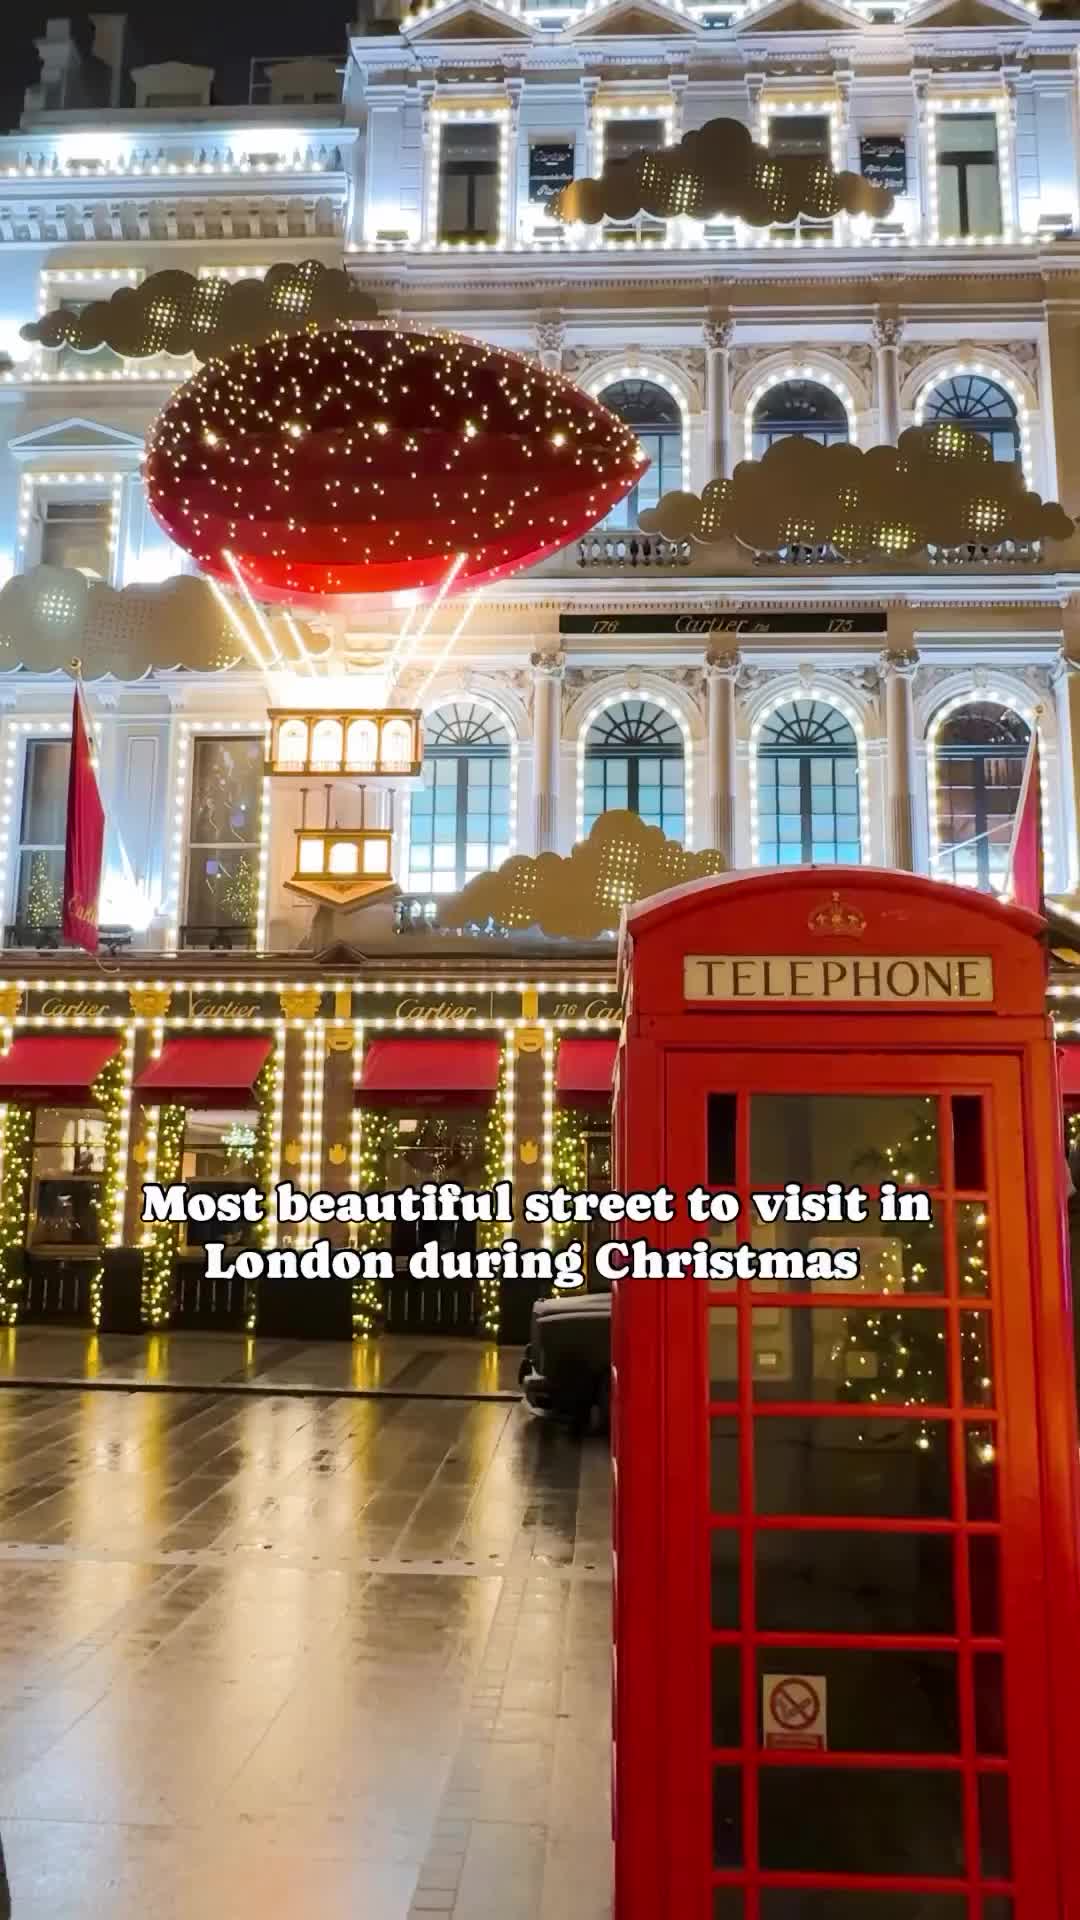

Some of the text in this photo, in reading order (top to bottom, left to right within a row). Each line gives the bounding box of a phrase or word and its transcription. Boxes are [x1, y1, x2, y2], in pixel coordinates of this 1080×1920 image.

[592, 620, 620, 633] 176
[675, 615, 748, 633] Cartier
[827, 618, 854, 632] 175
[696, 960, 981, 997] TELEPHONE
[41, 997, 111, 1017] Cartier
[191, 999, 261, 1017] Cartier
[396, 998, 477, 1020] Cartier
[553, 1003, 578, 1017] 176
